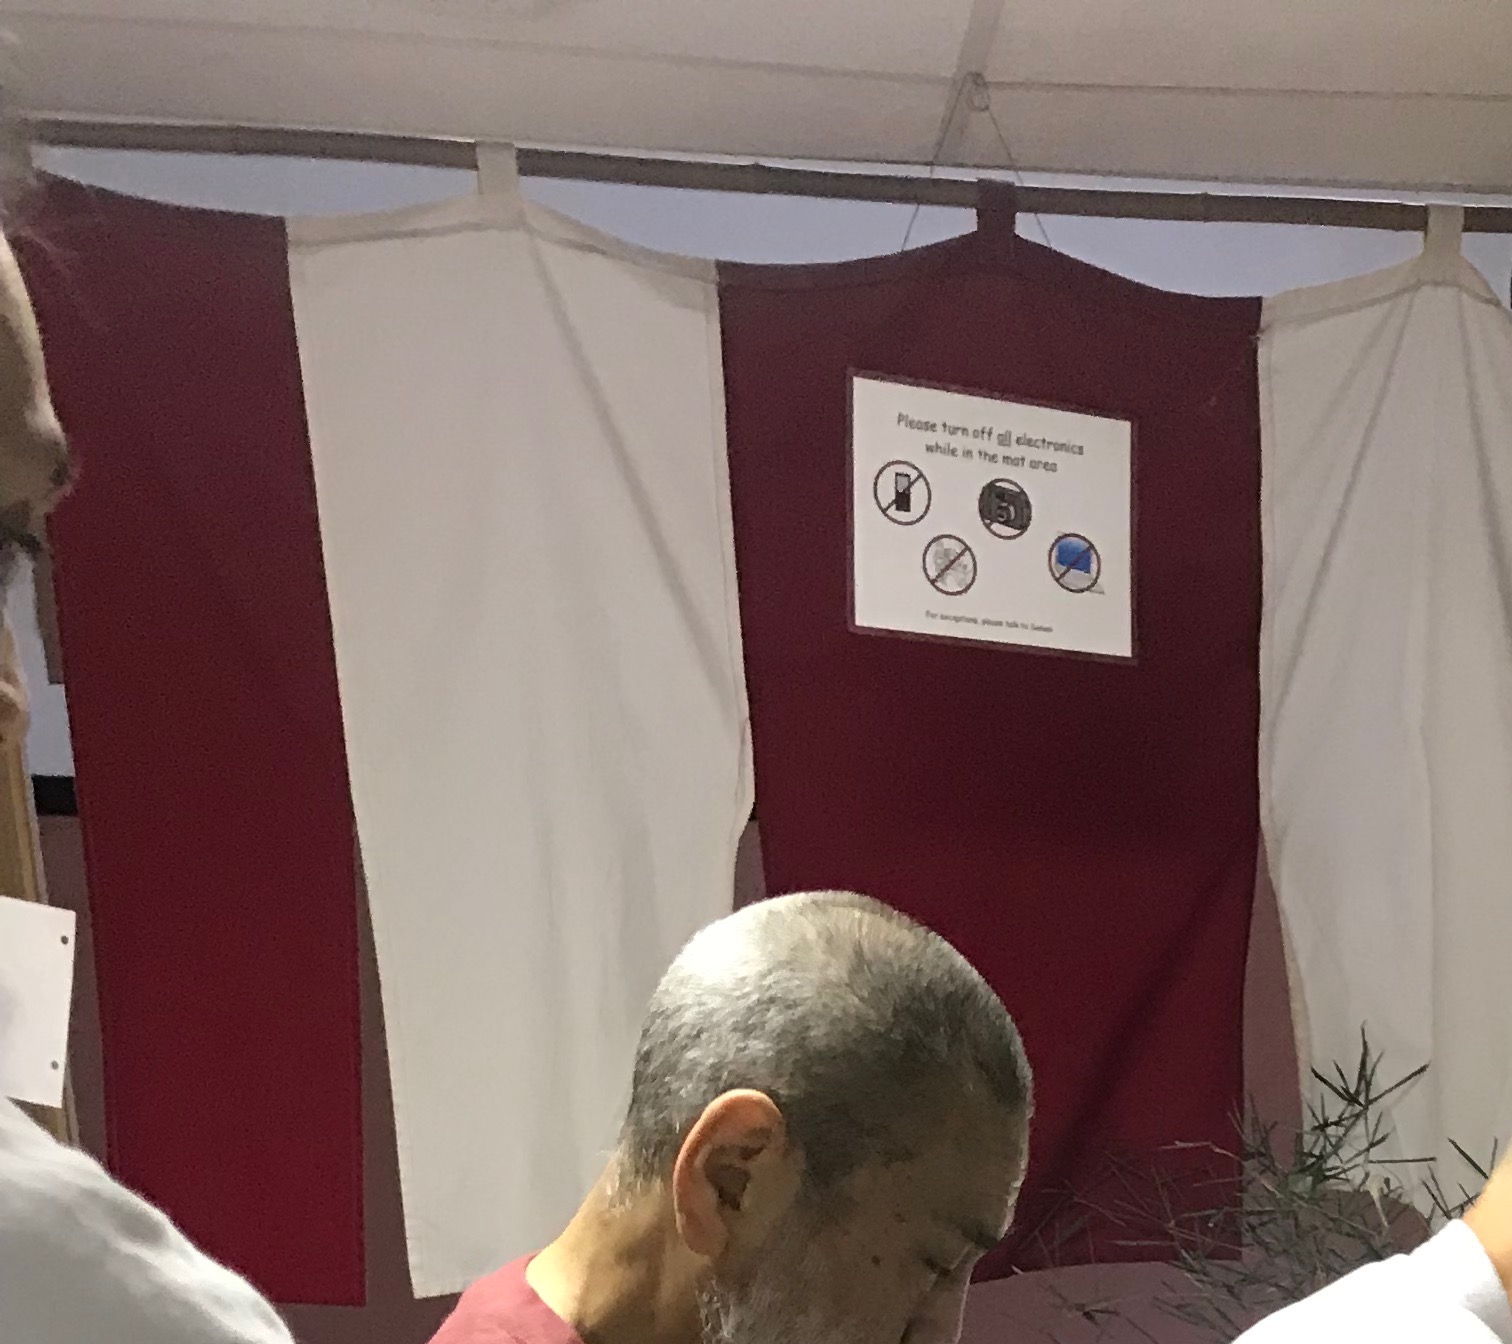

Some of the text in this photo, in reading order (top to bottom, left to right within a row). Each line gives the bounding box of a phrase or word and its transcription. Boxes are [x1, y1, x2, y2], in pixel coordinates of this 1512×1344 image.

[897, 412, 1084, 455] Please turn off all electronics
[925, 442, 1057, 472] while in the mat area
